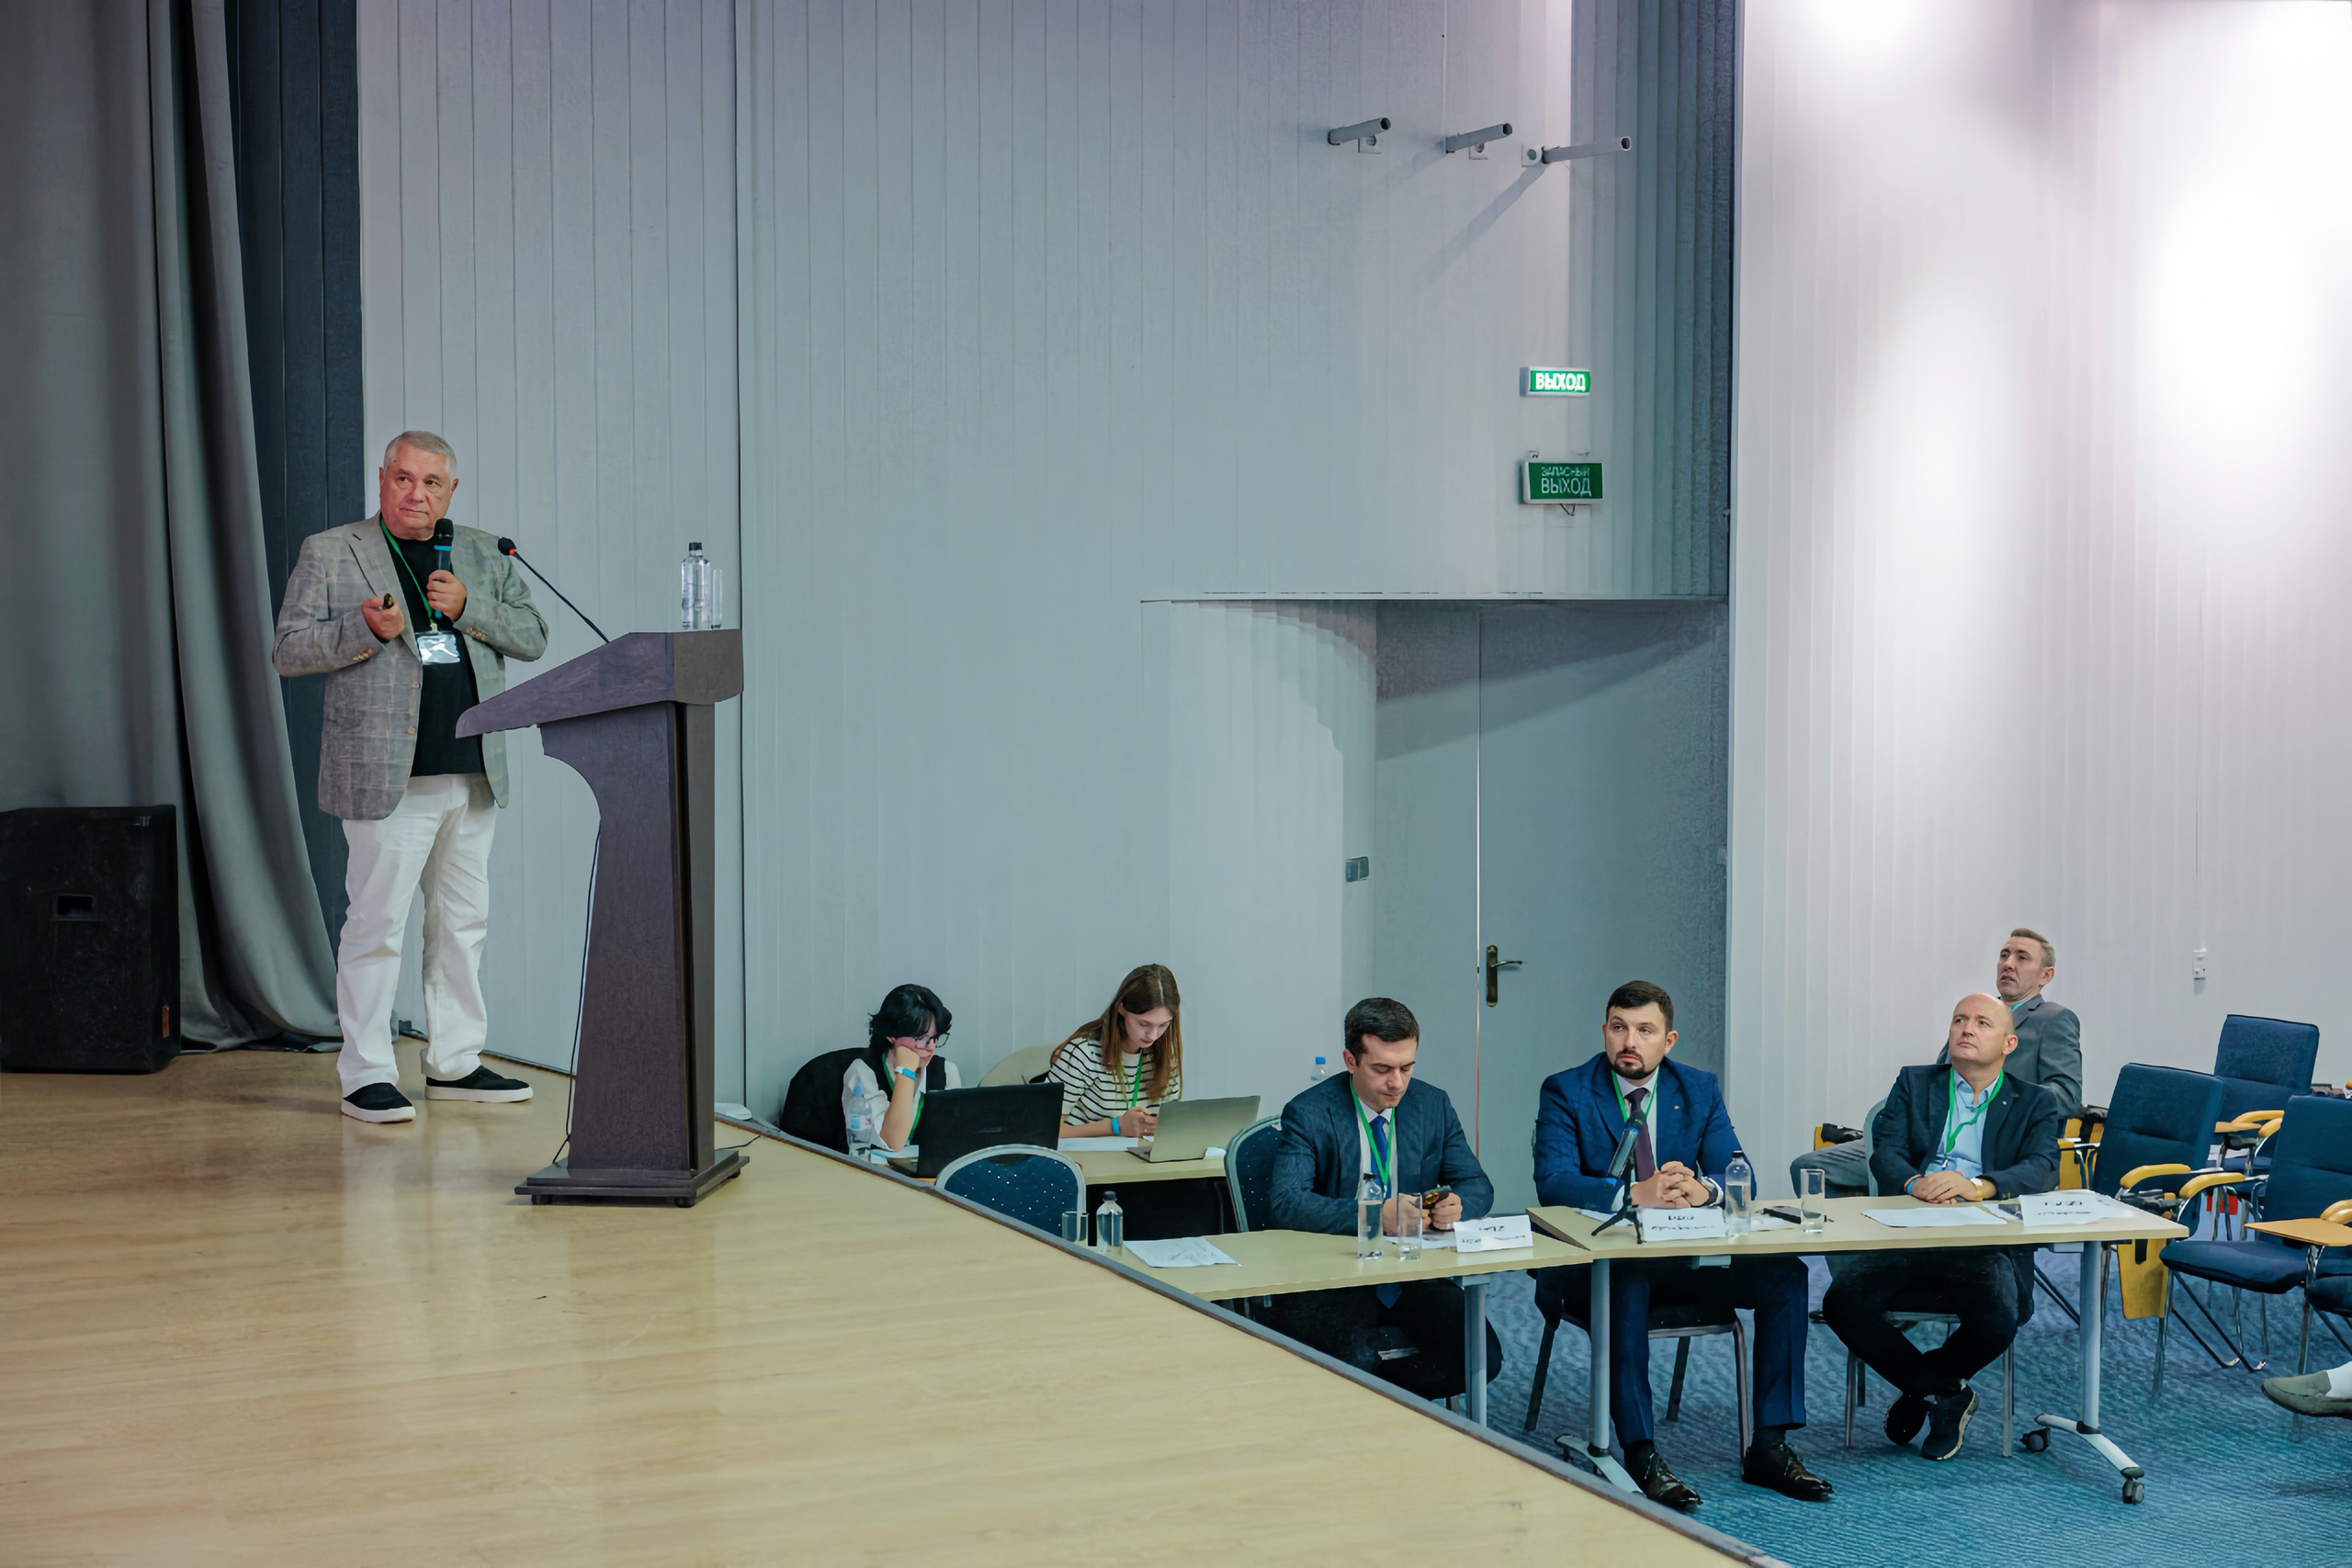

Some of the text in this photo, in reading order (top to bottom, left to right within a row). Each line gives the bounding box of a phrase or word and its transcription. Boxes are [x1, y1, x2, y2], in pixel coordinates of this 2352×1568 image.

[1535, 372, 1587, 392] ВЫХОД
[1541, 466, 1590, 477] ЗАПАСНЫЙ
[1541, 478, 1592, 497] ВЫХОД
